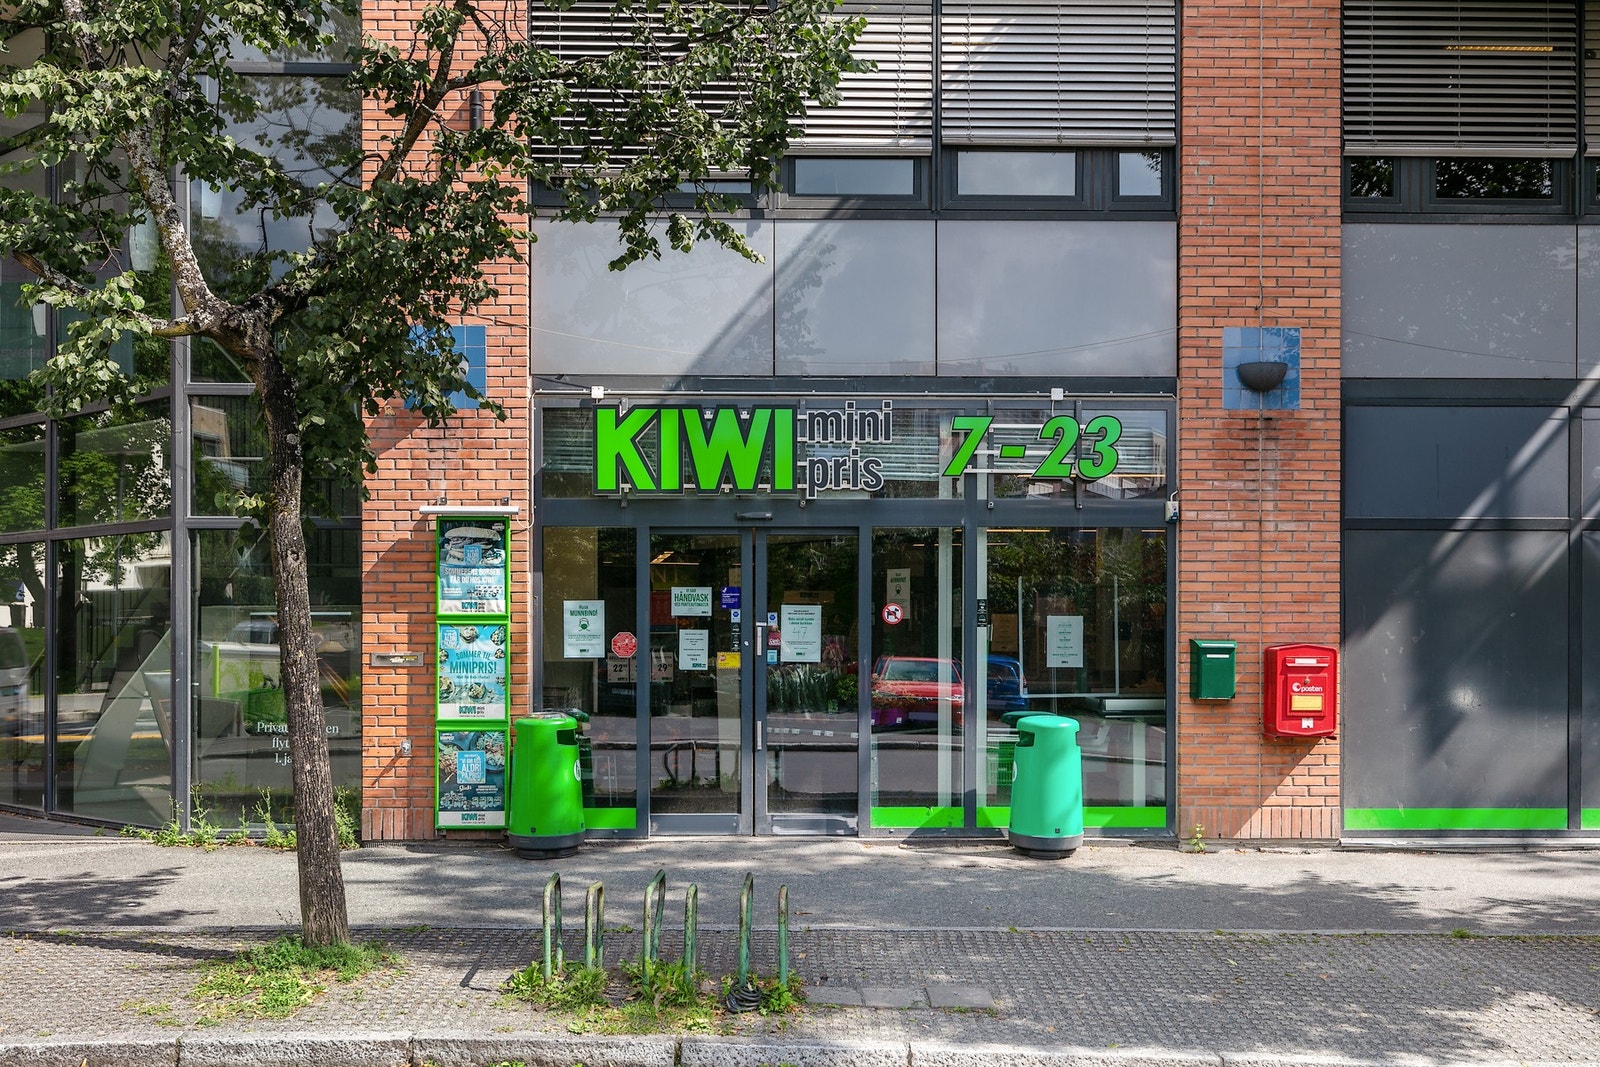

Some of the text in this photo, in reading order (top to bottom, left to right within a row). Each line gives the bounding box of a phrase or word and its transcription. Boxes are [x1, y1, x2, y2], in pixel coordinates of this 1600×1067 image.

[807, 400, 892, 442] mini
[594, 405, 797, 494] KIWI
[942, 415, 1122, 479] 7 - 23
[807, 448, 884, 499] pris
[674, 591, 709, 602] HÅNDVASK
[456, 651, 490, 660] SOMMER TIL
[450, 661, 497, 674] MINIPRIS!
[613, 664, 623, 672] 22
[658, 664, 667, 672] 29
[1301, 685, 1323, 693] posten
[272, 736, 289, 751] flyt
[282, 753, 292, 766] ja
